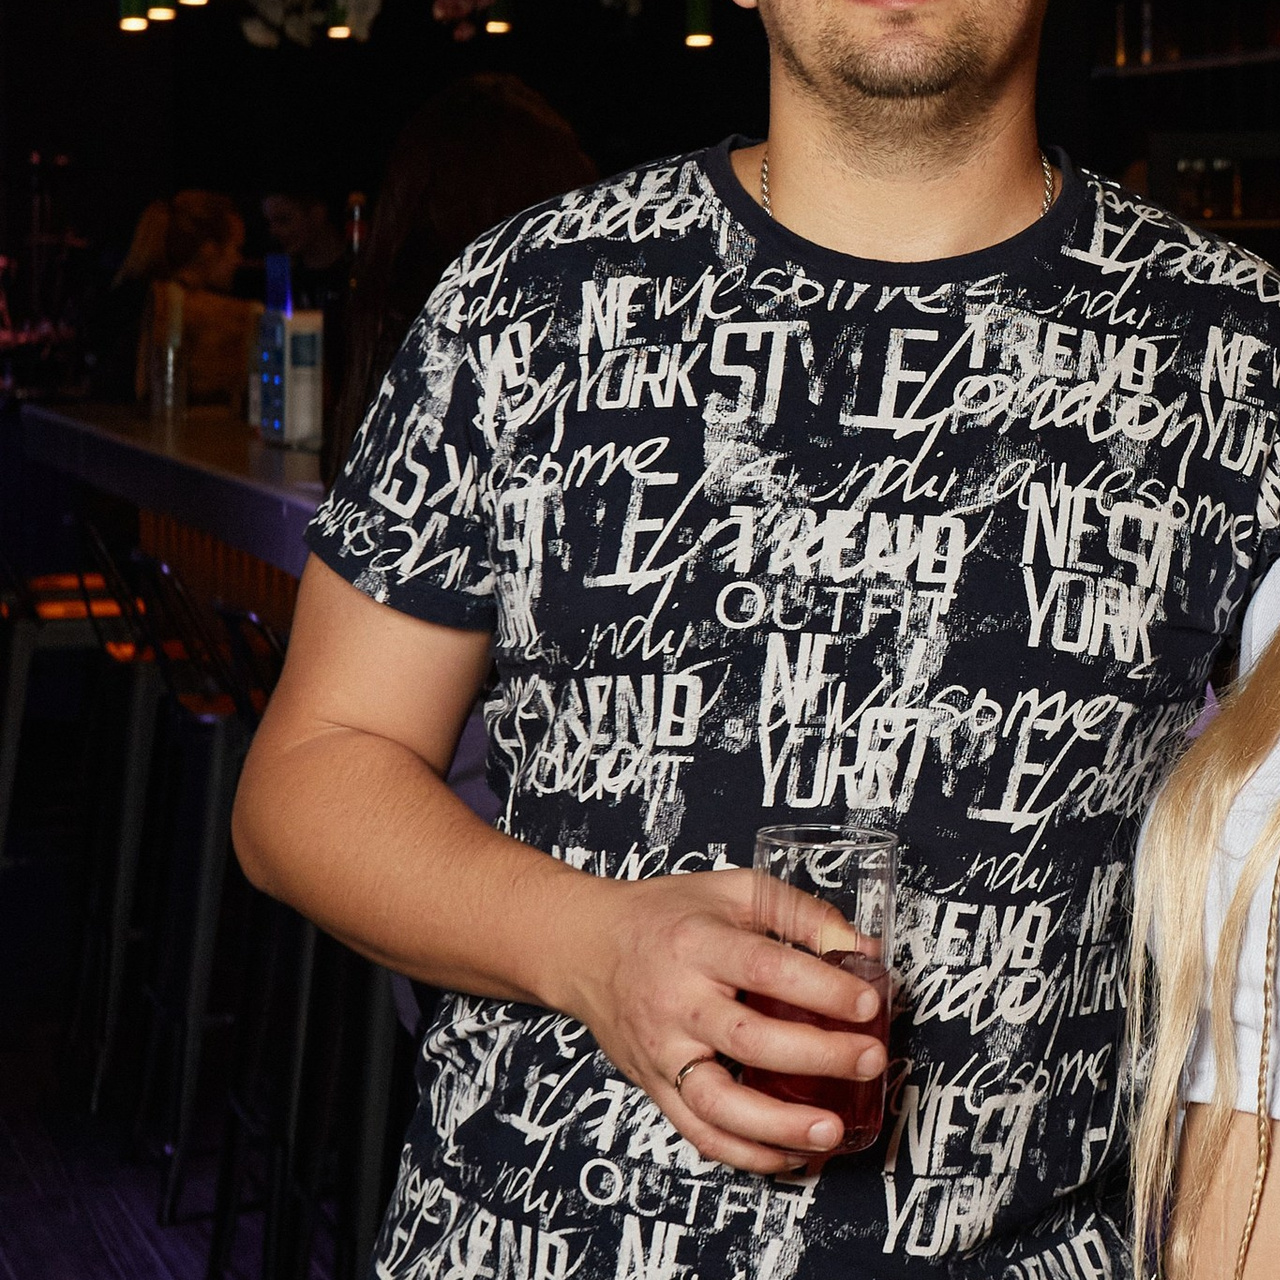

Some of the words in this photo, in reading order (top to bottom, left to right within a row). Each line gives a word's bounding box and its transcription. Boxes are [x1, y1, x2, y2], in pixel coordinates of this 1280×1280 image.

[576, 341, 707, 410] YORK
[714, 580, 958, 638] OUTFIT
[580, 1157, 816, 1240] OUTFIT
